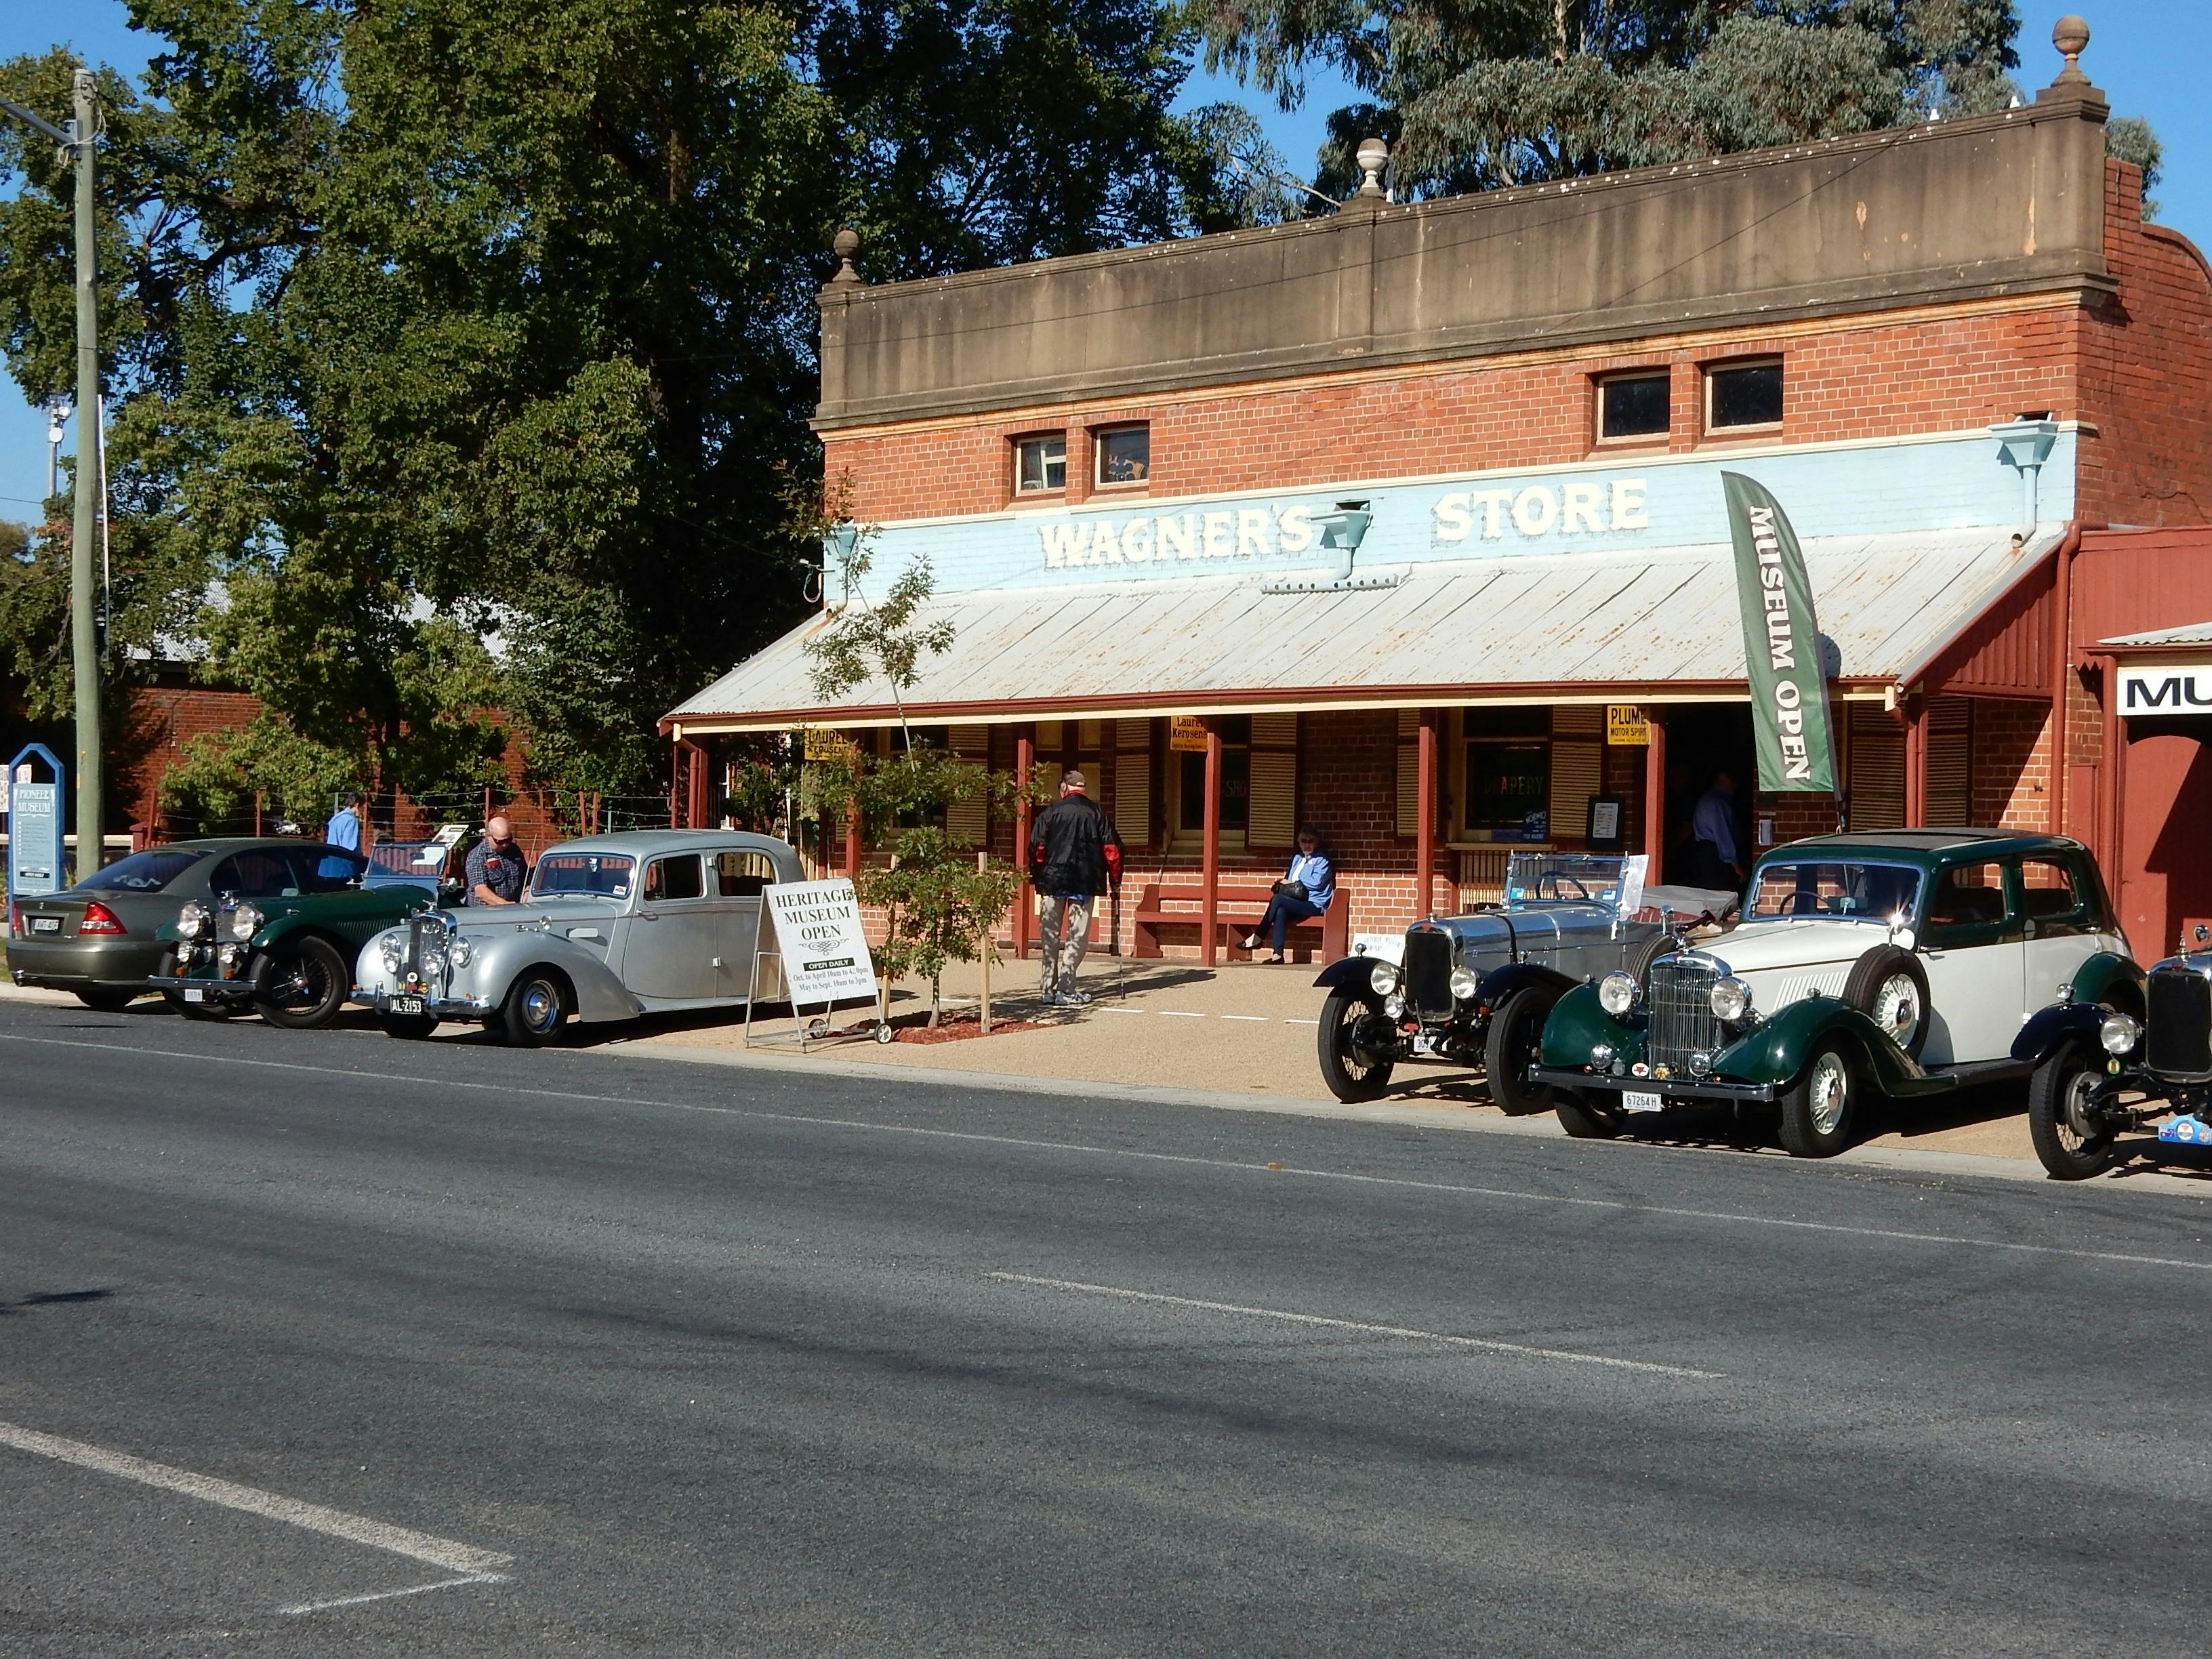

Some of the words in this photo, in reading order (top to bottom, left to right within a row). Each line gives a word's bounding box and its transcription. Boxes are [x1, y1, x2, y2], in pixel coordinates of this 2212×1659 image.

[1038, 503, 1313, 571] WAGNER'S
[1431, 478, 1648, 546] STORE
[1750, 506, 1795, 670] MUSEUM
[1776, 680, 1811, 780] OPEN
[2127, 676, 2212, 708] MU
[808, 729, 847, 745] LAUREL
[1172, 728, 1208, 739] Kerosene
[1610, 728, 1629, 736] MOTOR
[20, 790, 49, 800] PIONEER
[18, 802, 50, 813] MUSEUM
[776, 888, 853, 907] HERITAGE
[785, 906, 850, 924] MUSEUM
[802, 924, 841, 940] OPEN
[808, 962, 827, 970] OPEN
[813, 970, 826, 981] April
[819, 981, 832, 990] Sept.
[855, 977, 867, 985] 3pm
[392, 1000, 422, 1012] AL-2153
